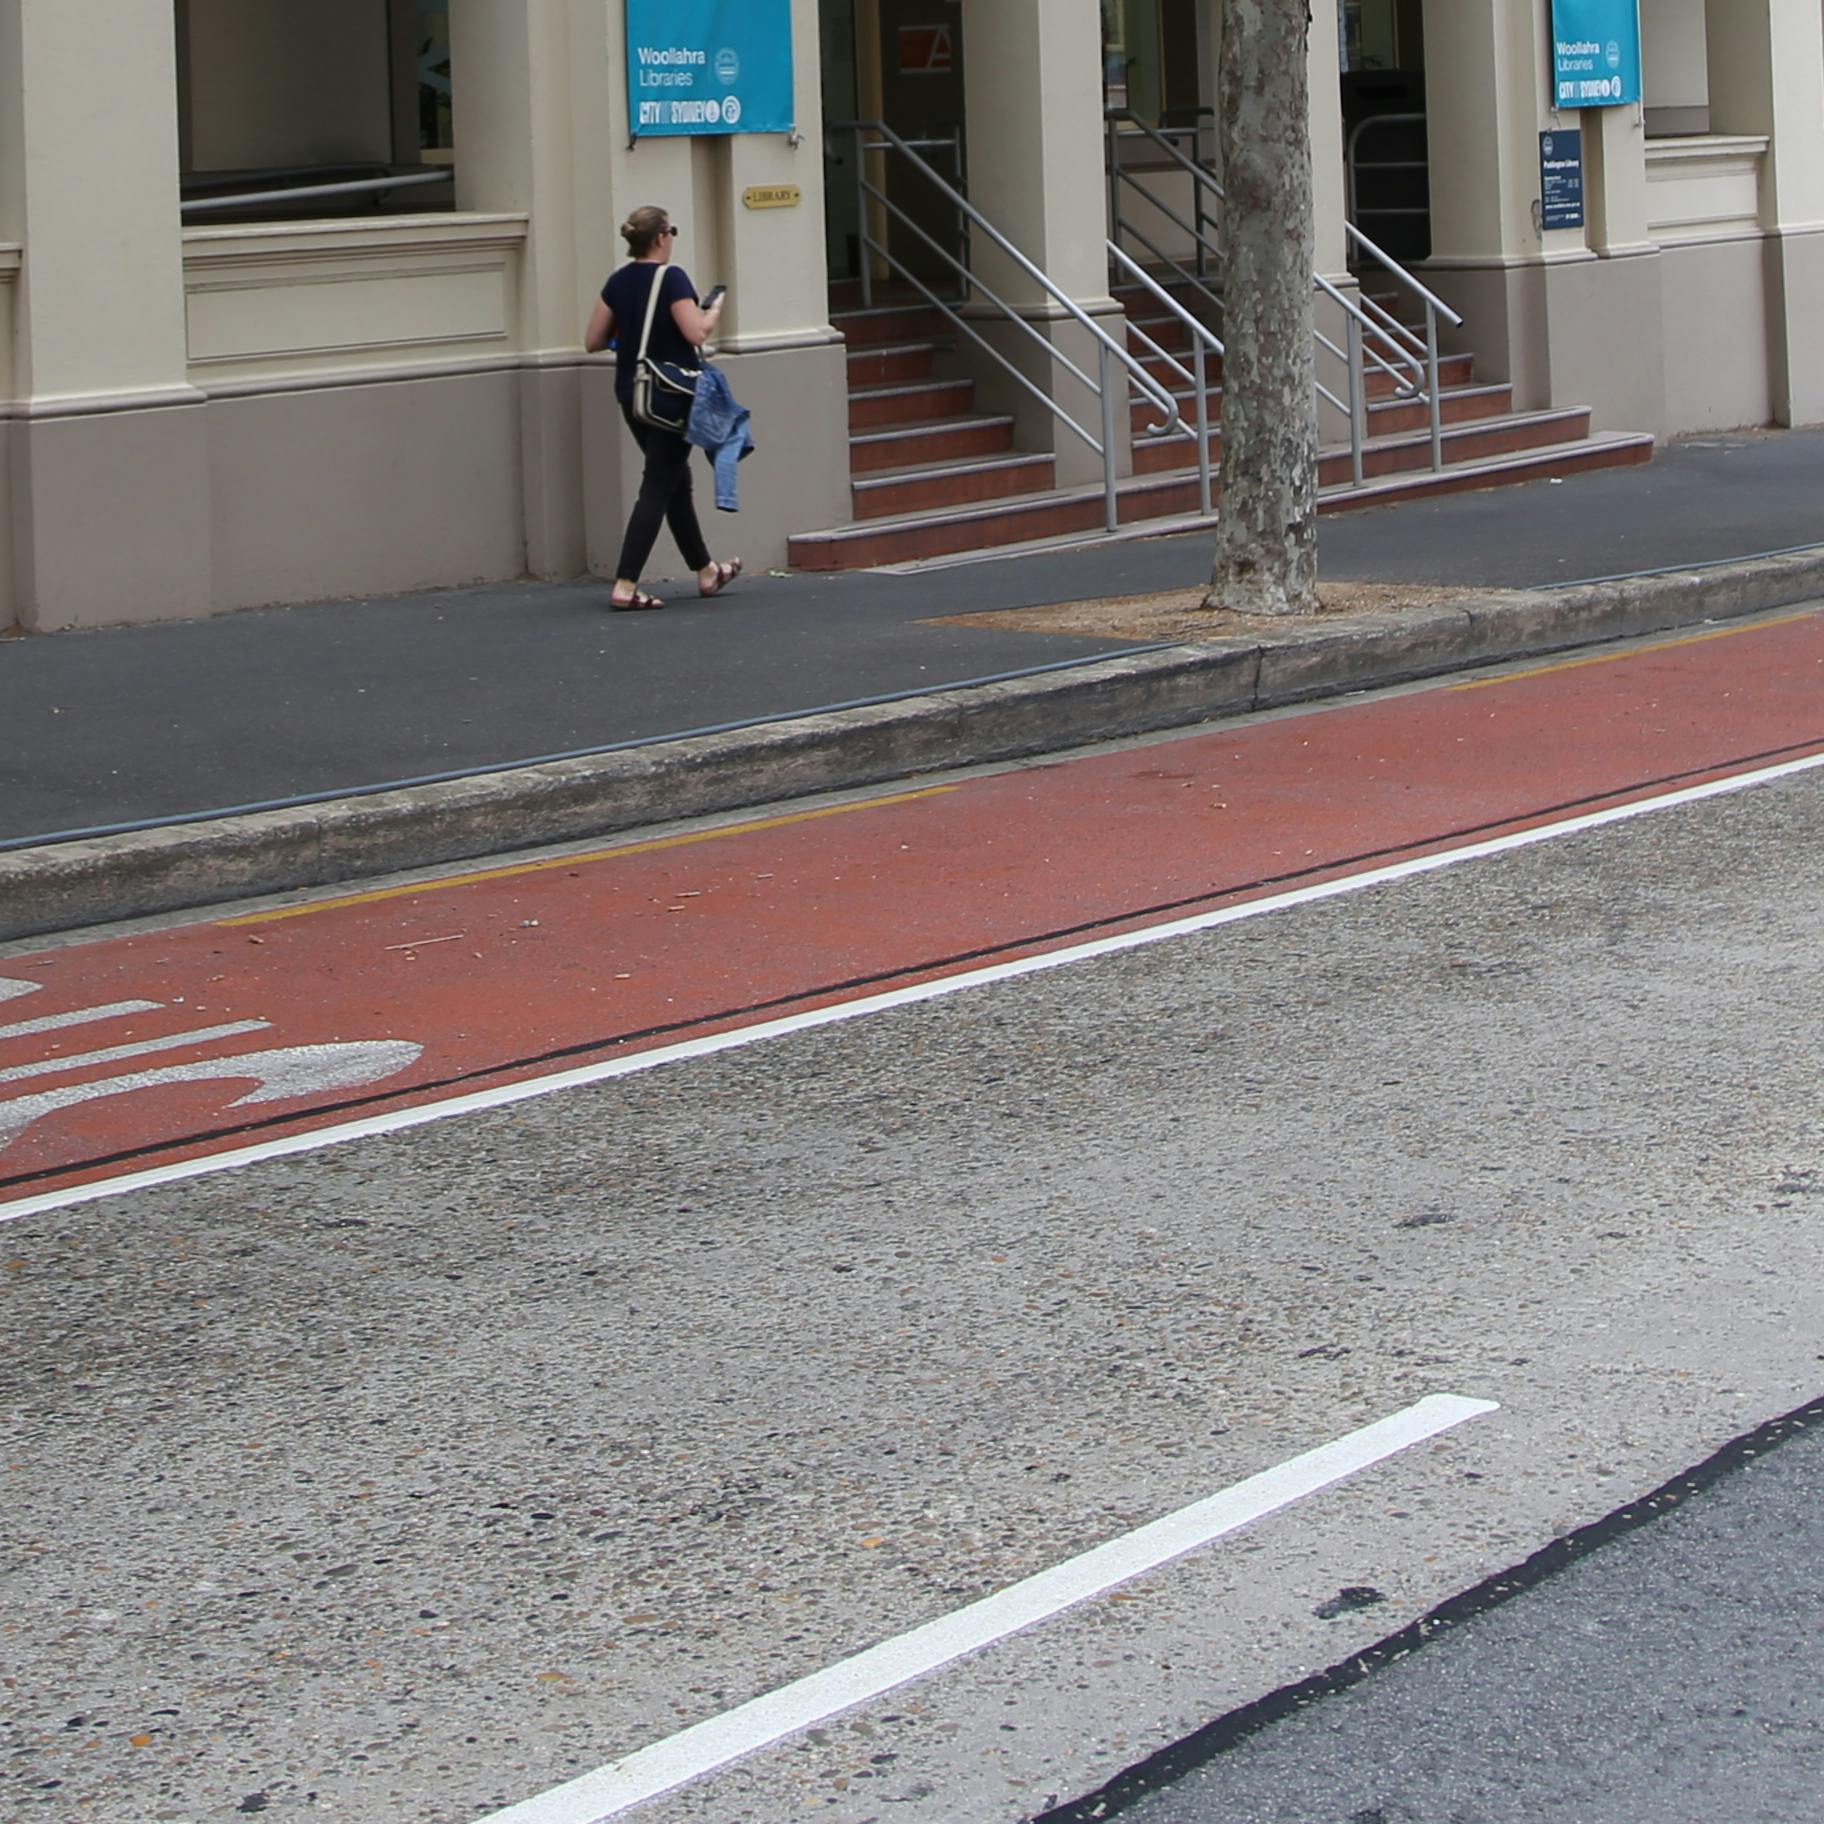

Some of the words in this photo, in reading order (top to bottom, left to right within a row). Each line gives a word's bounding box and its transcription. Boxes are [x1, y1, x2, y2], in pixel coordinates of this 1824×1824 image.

[1556, 41, 1601, 55] Woollahra
[637, 47, 706, 65] Woollahra
[1558, 58, 1594, 72] Libraries
[639, 69, 694, 87] Libraries
[752, 190, 791, 203] LIBRARY
